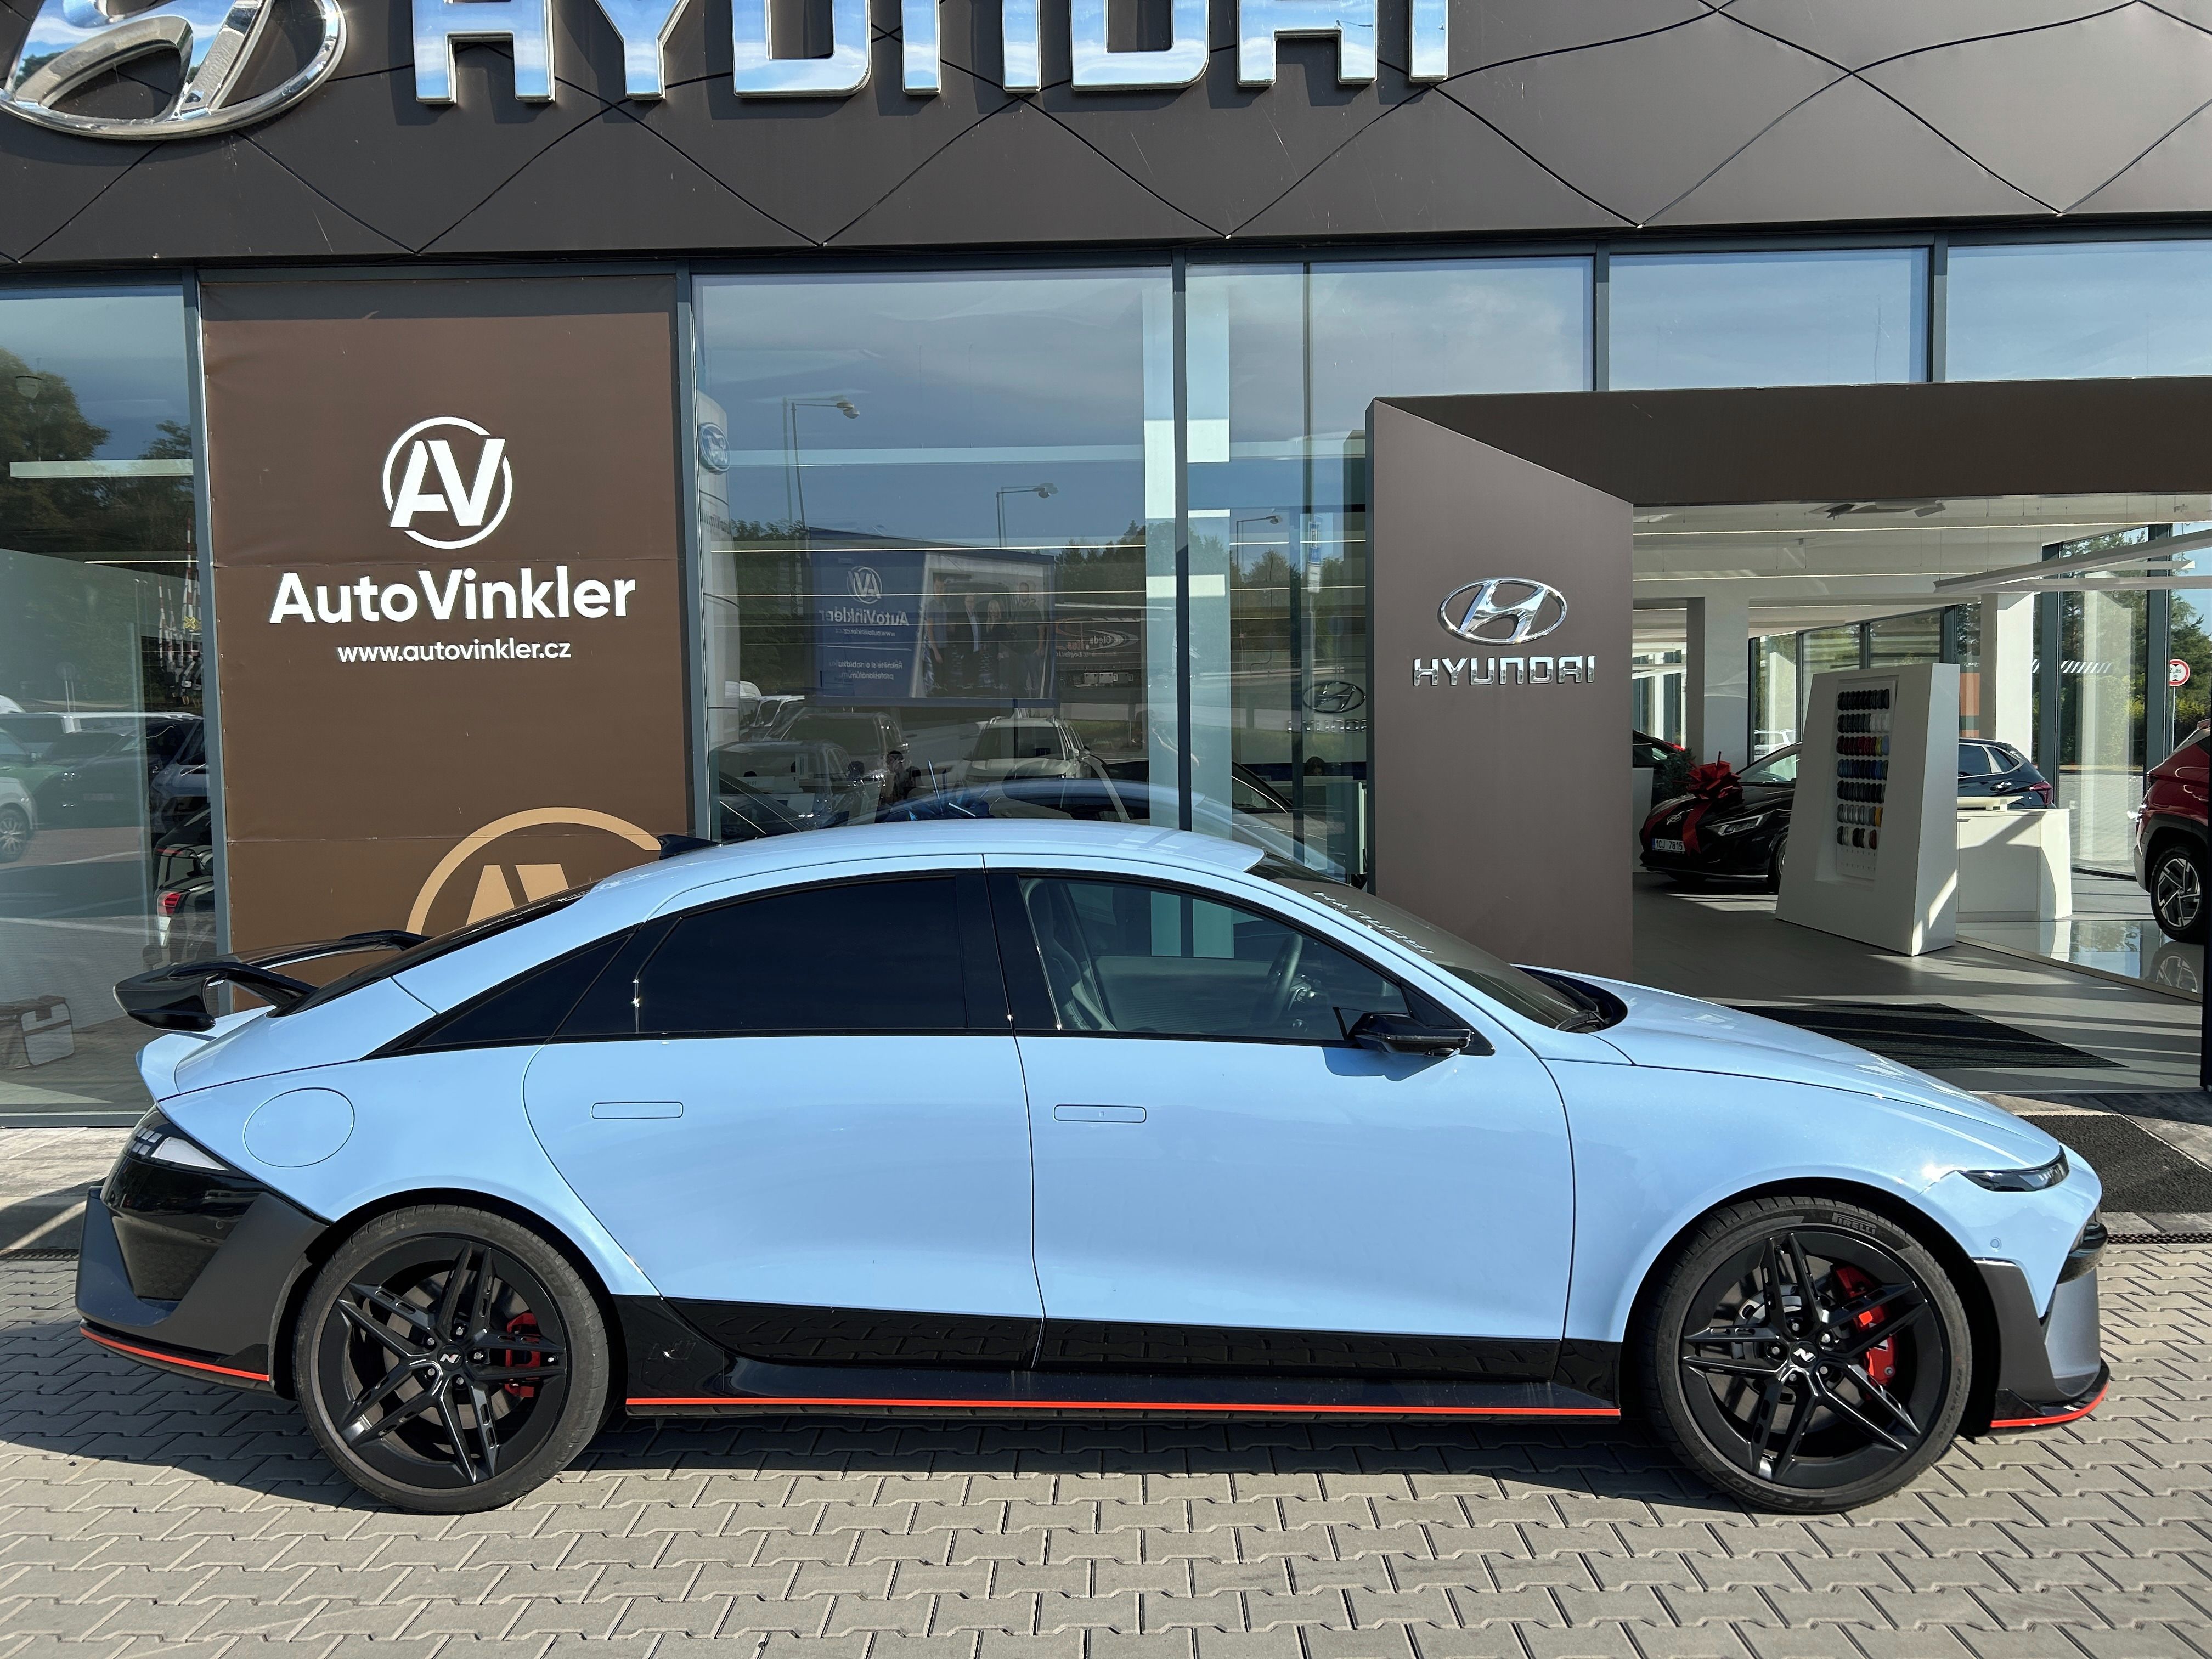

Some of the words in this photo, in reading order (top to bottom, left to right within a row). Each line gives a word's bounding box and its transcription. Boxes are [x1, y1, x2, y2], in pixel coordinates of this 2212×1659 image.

[269, 565, 636, 624] AutoVinkler
[336, 637, 571, 662] www.autovinkler.cz
[1413, 656, 1595, 686] HYUNDAI
[1668, 841, 1683, 850] 7815
[1831, 1212, 1877, 1235] PIRELLI
